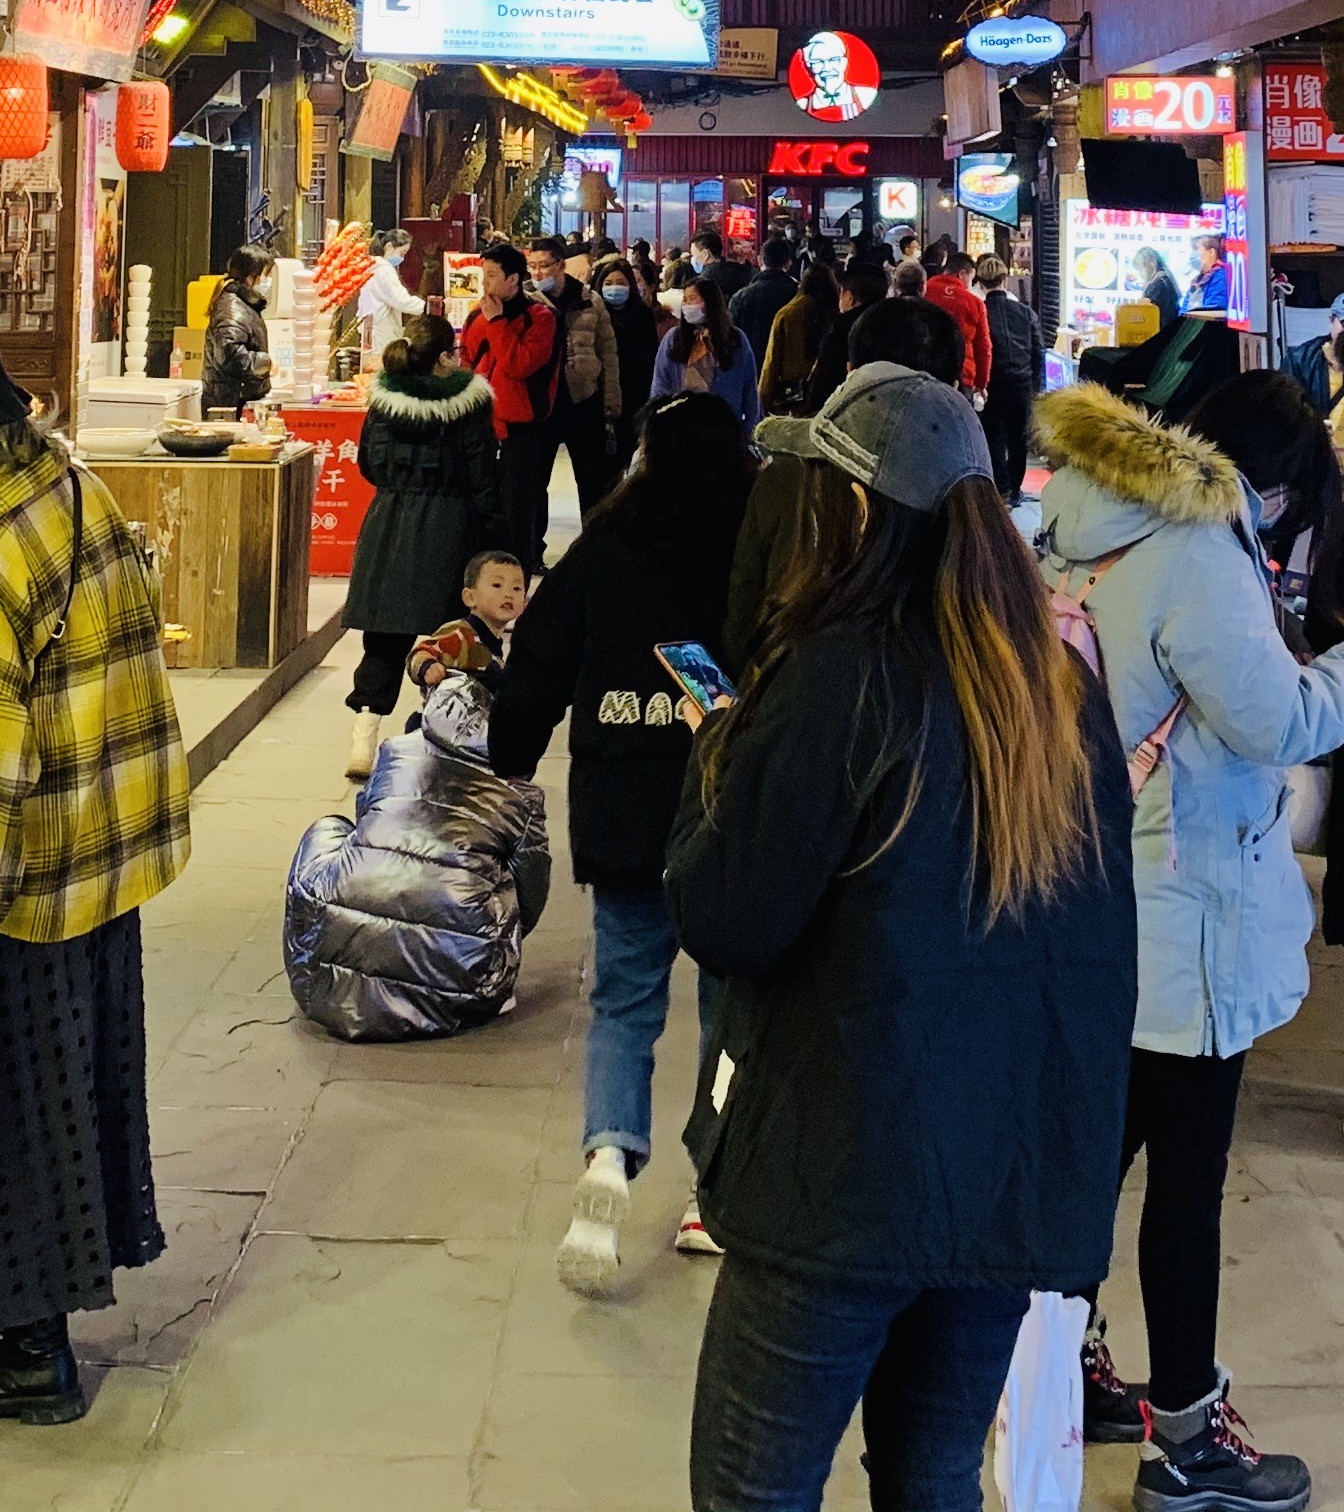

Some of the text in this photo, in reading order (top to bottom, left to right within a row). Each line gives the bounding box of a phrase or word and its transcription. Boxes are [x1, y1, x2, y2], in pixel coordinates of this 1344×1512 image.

[497, 4, 595, 19] Downstairs
[980, 33, 1053, 49] Häagen-Dazs
[1114, 81, 1154, 101] 肖像
[1265, 72, 1322, 109] 肖像
[1112, 107, 1154, 127] 漫画
[1152, 82, 1214, 130] 20
[1266, 116, 1323, 151] 漫画
[768, 142, 870, 176] KFC
[886, 185, 907, 210] K
